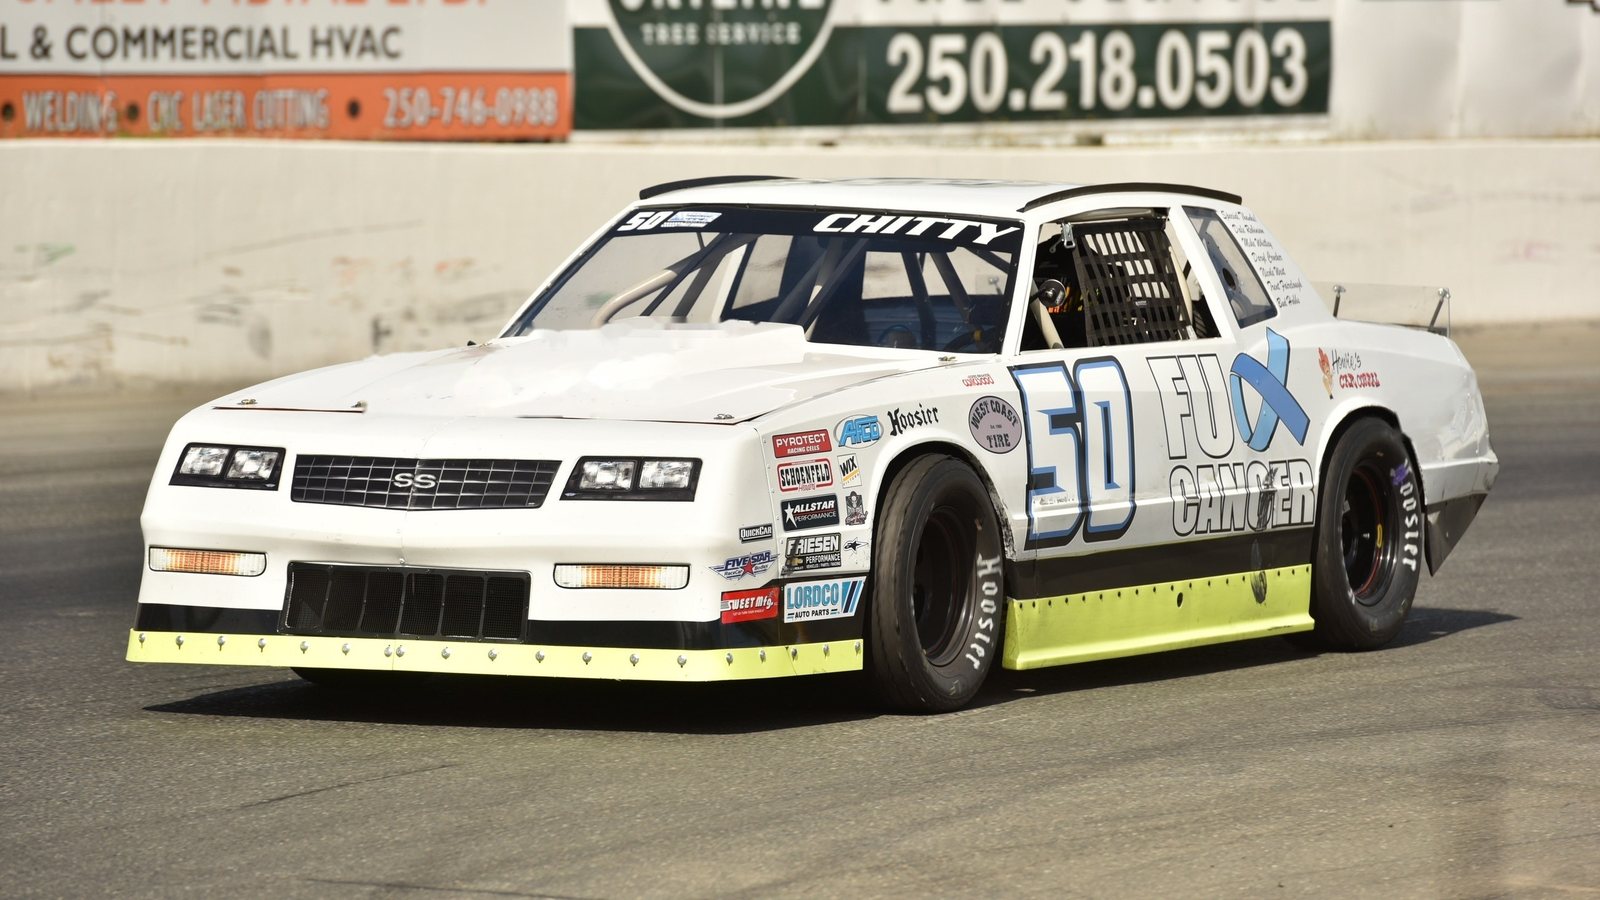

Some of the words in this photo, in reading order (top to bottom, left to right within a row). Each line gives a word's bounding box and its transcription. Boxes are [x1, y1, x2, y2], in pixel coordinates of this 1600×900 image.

[30, 24, 51, 60] &
[65, 26, 298, 60] COMMERCIAL
[309, 25, 401, 59] HVAC
[641, 22, 699, 45] TREE
[706, 22, 801, 45] SERVICE
[886, 28, 1308, 113] 250.218.0503
[22, 91, 117, 131] WELDING
[617, 211, 674, 231] 50
[813, 213, 1020, 245] CHITTY
[887, 403, 939, 436] Hoosier
[971, 401, 991, 430] WEST
[990, 399, 1019, 428] COAST
[776, 433, 826, 448] PYROTECT
[838, 415, 880, 447] AFCO
[986, 433, 1011, 449] TIRE
[1007, 355, 1137, 550] 50
[780, 463, 830, 487] SCHOENFELD
[840, 456, 858, 477] WIX
[393, 472, 436, 489] SS
[794, 500, 835, 514] ALLSTAR
[1169, 459, 1316, 536] CANCER
[795, 511, 837, 522] PERFORMANCE
[786, 535, 839, 556] FRIESEN
[725, 555, 749, 570] FIVE
[751, 551, 771, 565] STAR
[806, 553, 840, 564] PERFORMANCE
[724, 597, 755, 611] SWEET
[786, 583, 839, 610] LORDCO
[795, 610, 810, 618] AUTO
[811, 608, 829, 617] PARTS
[965, 553, 1002, 669] Hoosier
